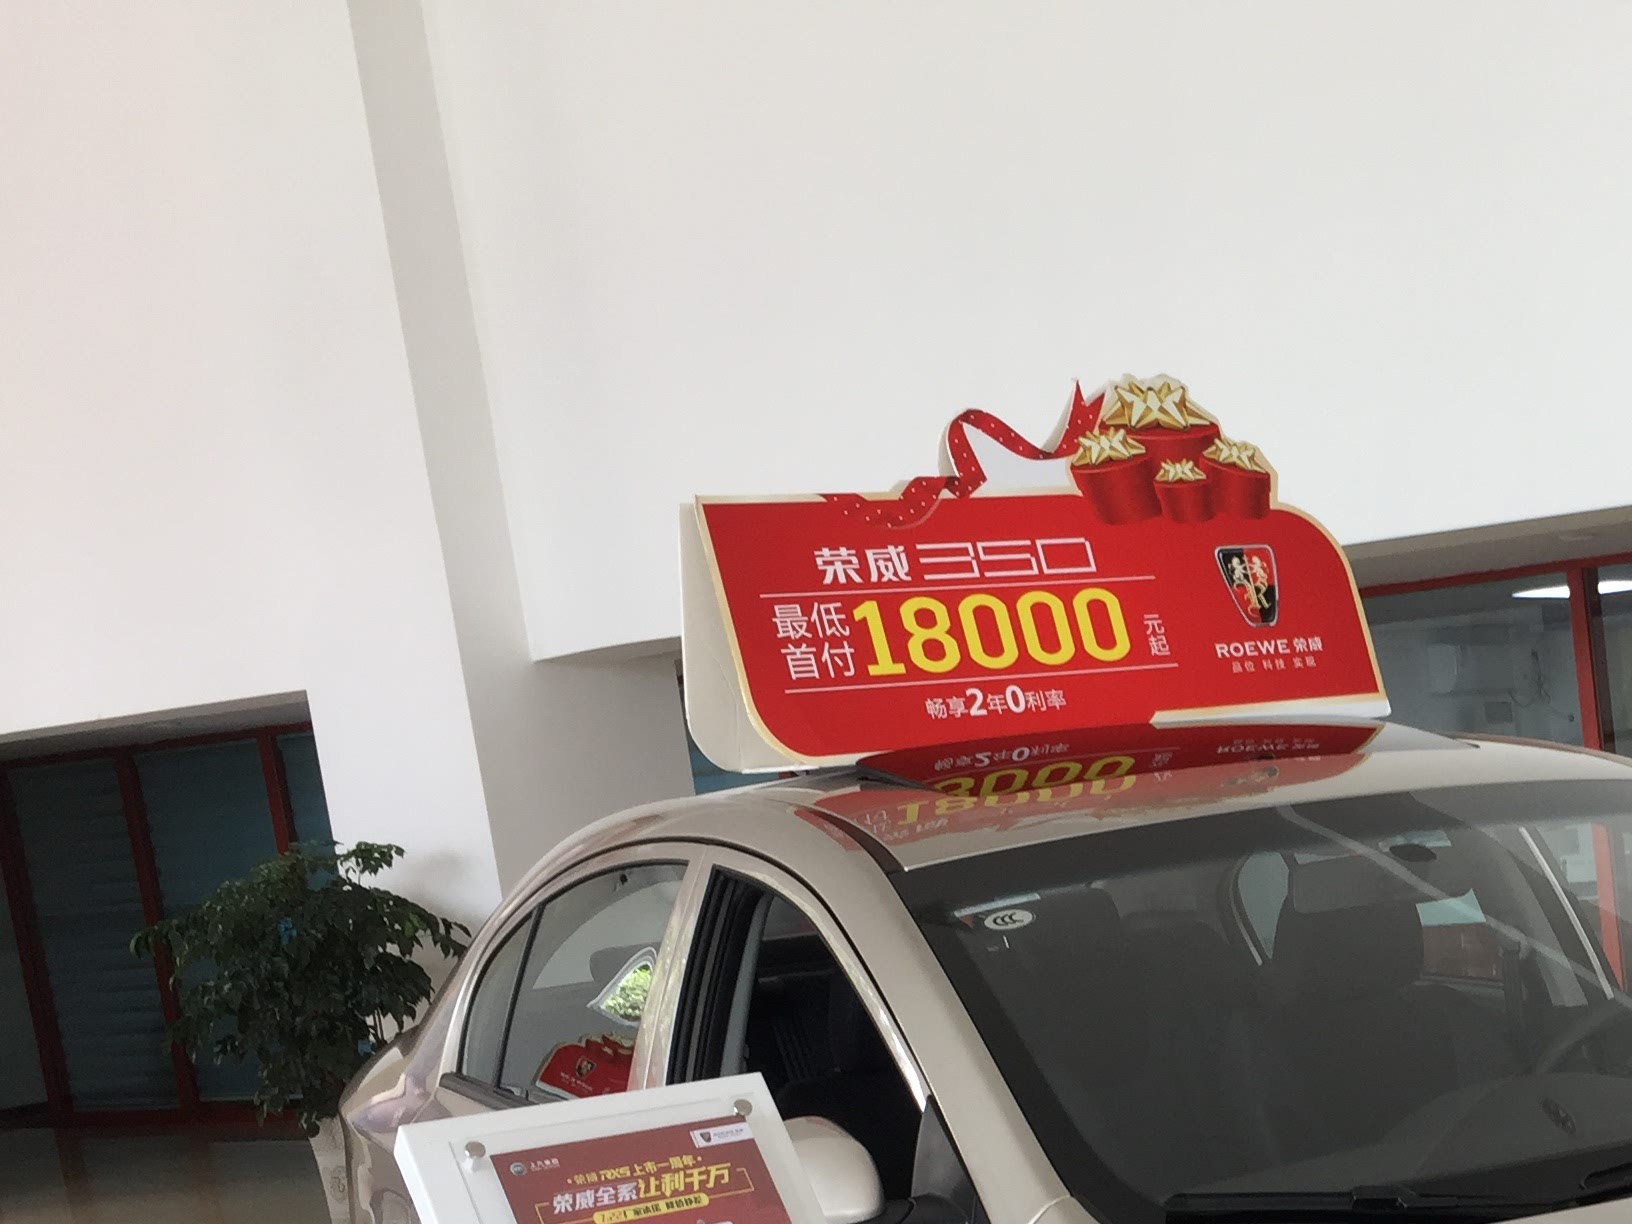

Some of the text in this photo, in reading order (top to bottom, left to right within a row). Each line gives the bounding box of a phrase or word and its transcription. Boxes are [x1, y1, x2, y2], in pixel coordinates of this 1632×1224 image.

[772, 601, 850, 641] 最低
[852, 587, 1131, 676] 18000
[781, 640, 856, 680] 首付
[1214, 639, 1291, 658] ROEWE
[925, 684, 1067, 719] 畅享2年0利率
[552, 1163, 732, 1215] 荣威全系让利千万
